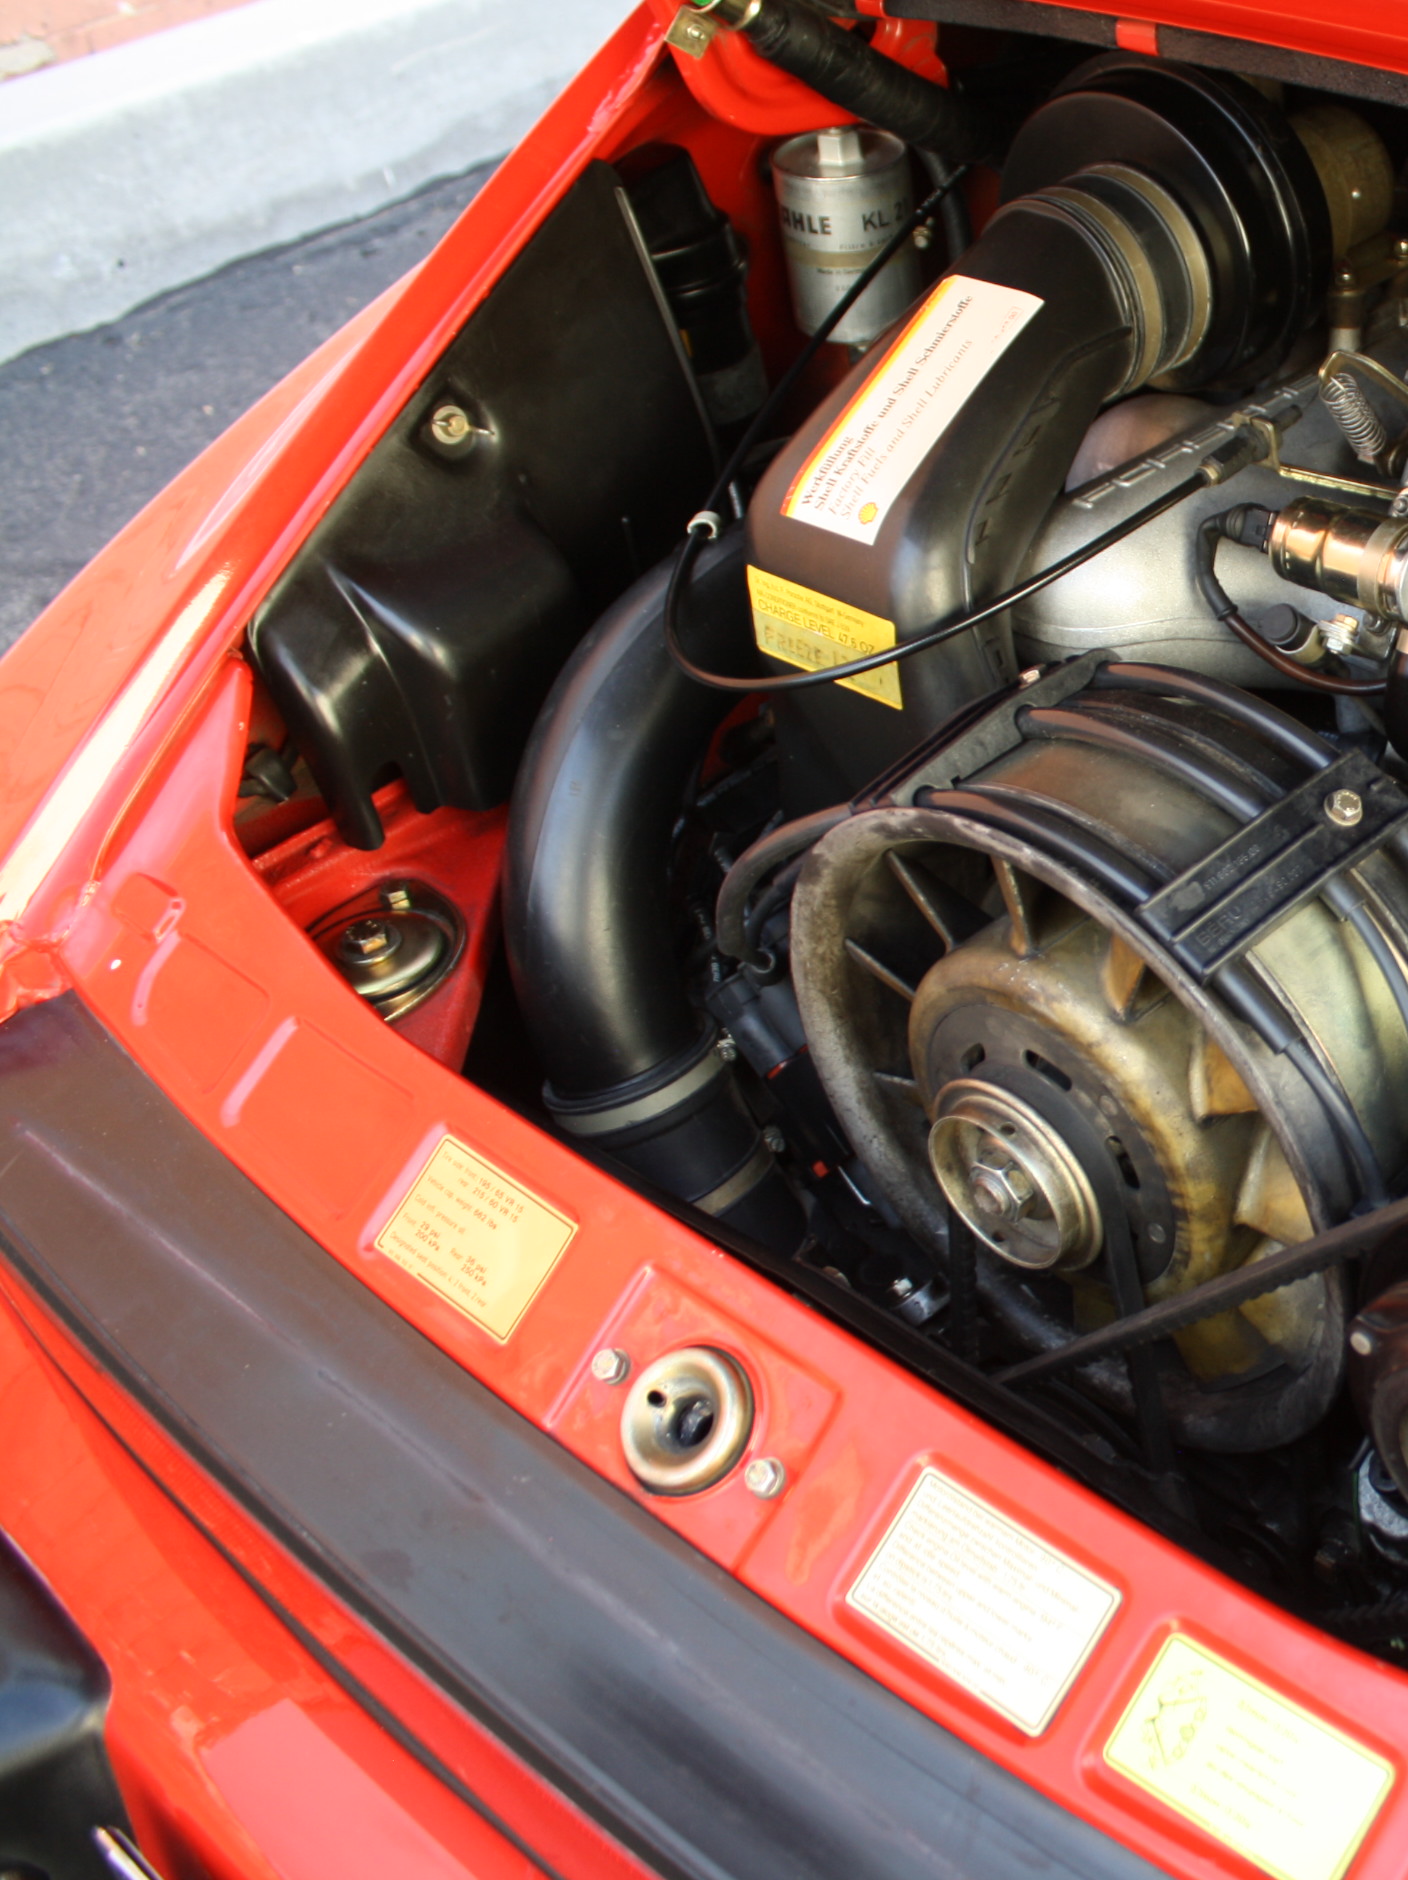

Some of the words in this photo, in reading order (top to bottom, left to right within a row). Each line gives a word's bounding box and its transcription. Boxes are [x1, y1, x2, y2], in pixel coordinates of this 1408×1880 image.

[780, 204, 832, 235] AHLE
[861, 208, 890, 232] KL
[814, 476, 838, 510] Shell
[834, 421, 880, 476] Kraftstoffe
[878, 397, 896, 418] und
[893, 367, 919, 395] Shell
[916, 295, 973, 365] Schmierstoffe
[841, 484, 861, 519] Shell
[861, 455, 888, 484] Fuels
[886, 429, 905, 452] and
[902, 400, 928, 427] Shell
[924, 339, 973, 397] Lubricants
[801, 436, 853, 505] Werkfüllung
[828, 472, 857, 515] Factory
[857, 448, 876, 470] Fill
[758, 597, 803, 623] CHARGE
[804, 615, 835, 641] LEVEL
[472, 1186, 485, 1199] 215
[488, 1198, 498, 1208] 60
[497, 1204, 509, 1216] VR
[508, 1213, 518, 1223] 15
[478, 1177, 491, 1189] 195
[503, 1195, 515, 1206] VR
[514, 1203, 524, 1213] 15
[414, 1228, 428, 1242] 200
[427, 1238, 441, 1251] kPa
[460, 1263, 475, 1277] 250
[473, 1272, 488, 1286] kPa
[420, 1221, 430, 1230] 29
[429, 1228, 440, 1239] psi
[474, 1263, 486, 1274] psi
